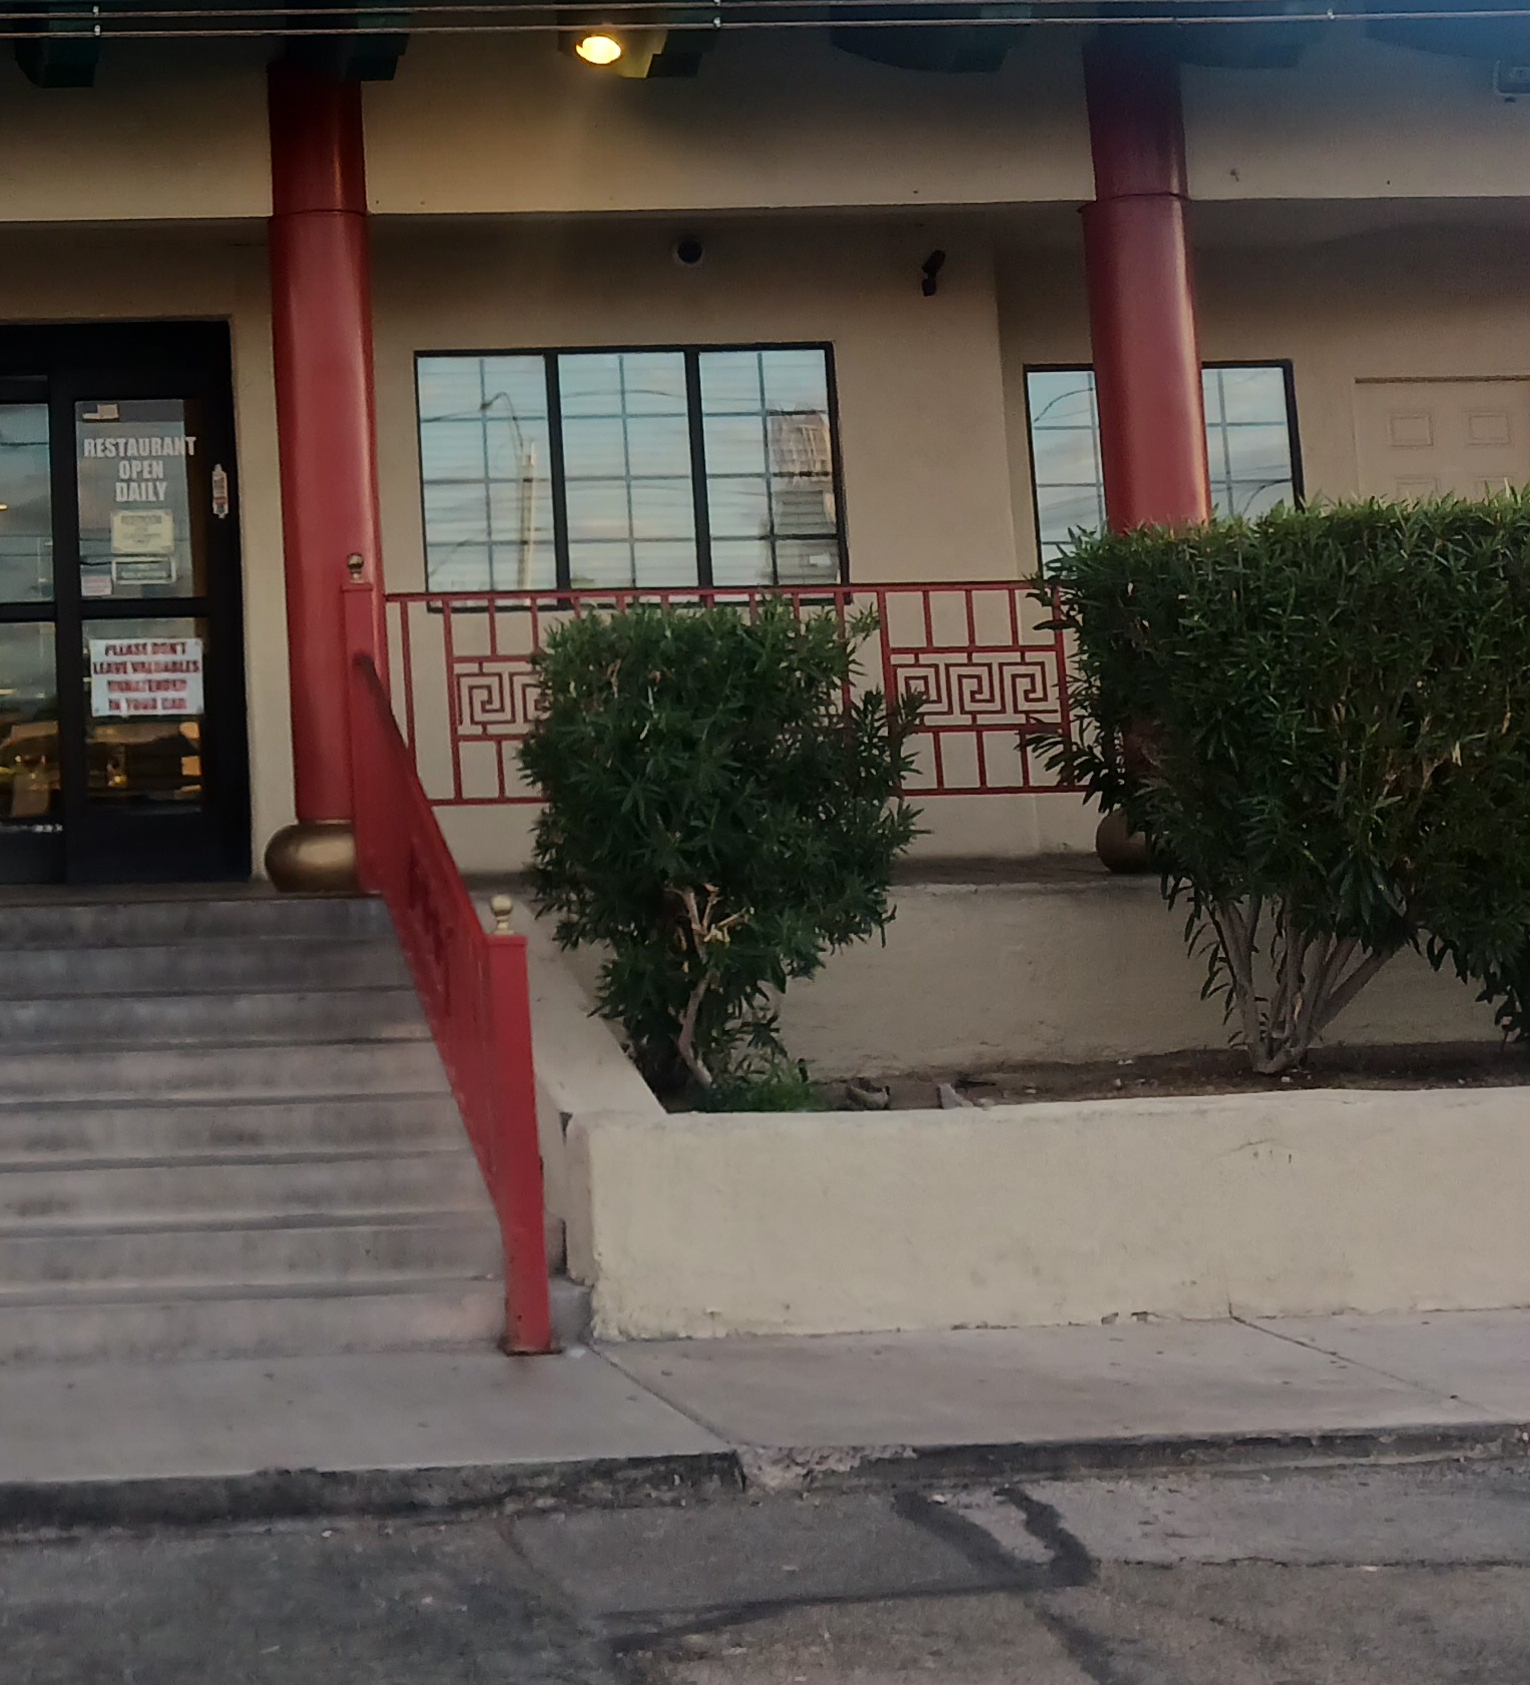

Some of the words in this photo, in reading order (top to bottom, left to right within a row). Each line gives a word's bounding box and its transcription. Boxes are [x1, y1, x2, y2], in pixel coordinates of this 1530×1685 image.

[83, 436, 197, 458] RESTAURANT
[118, 460, 164, 480] OPEN
[115, 481, 168, 502] DAILY
